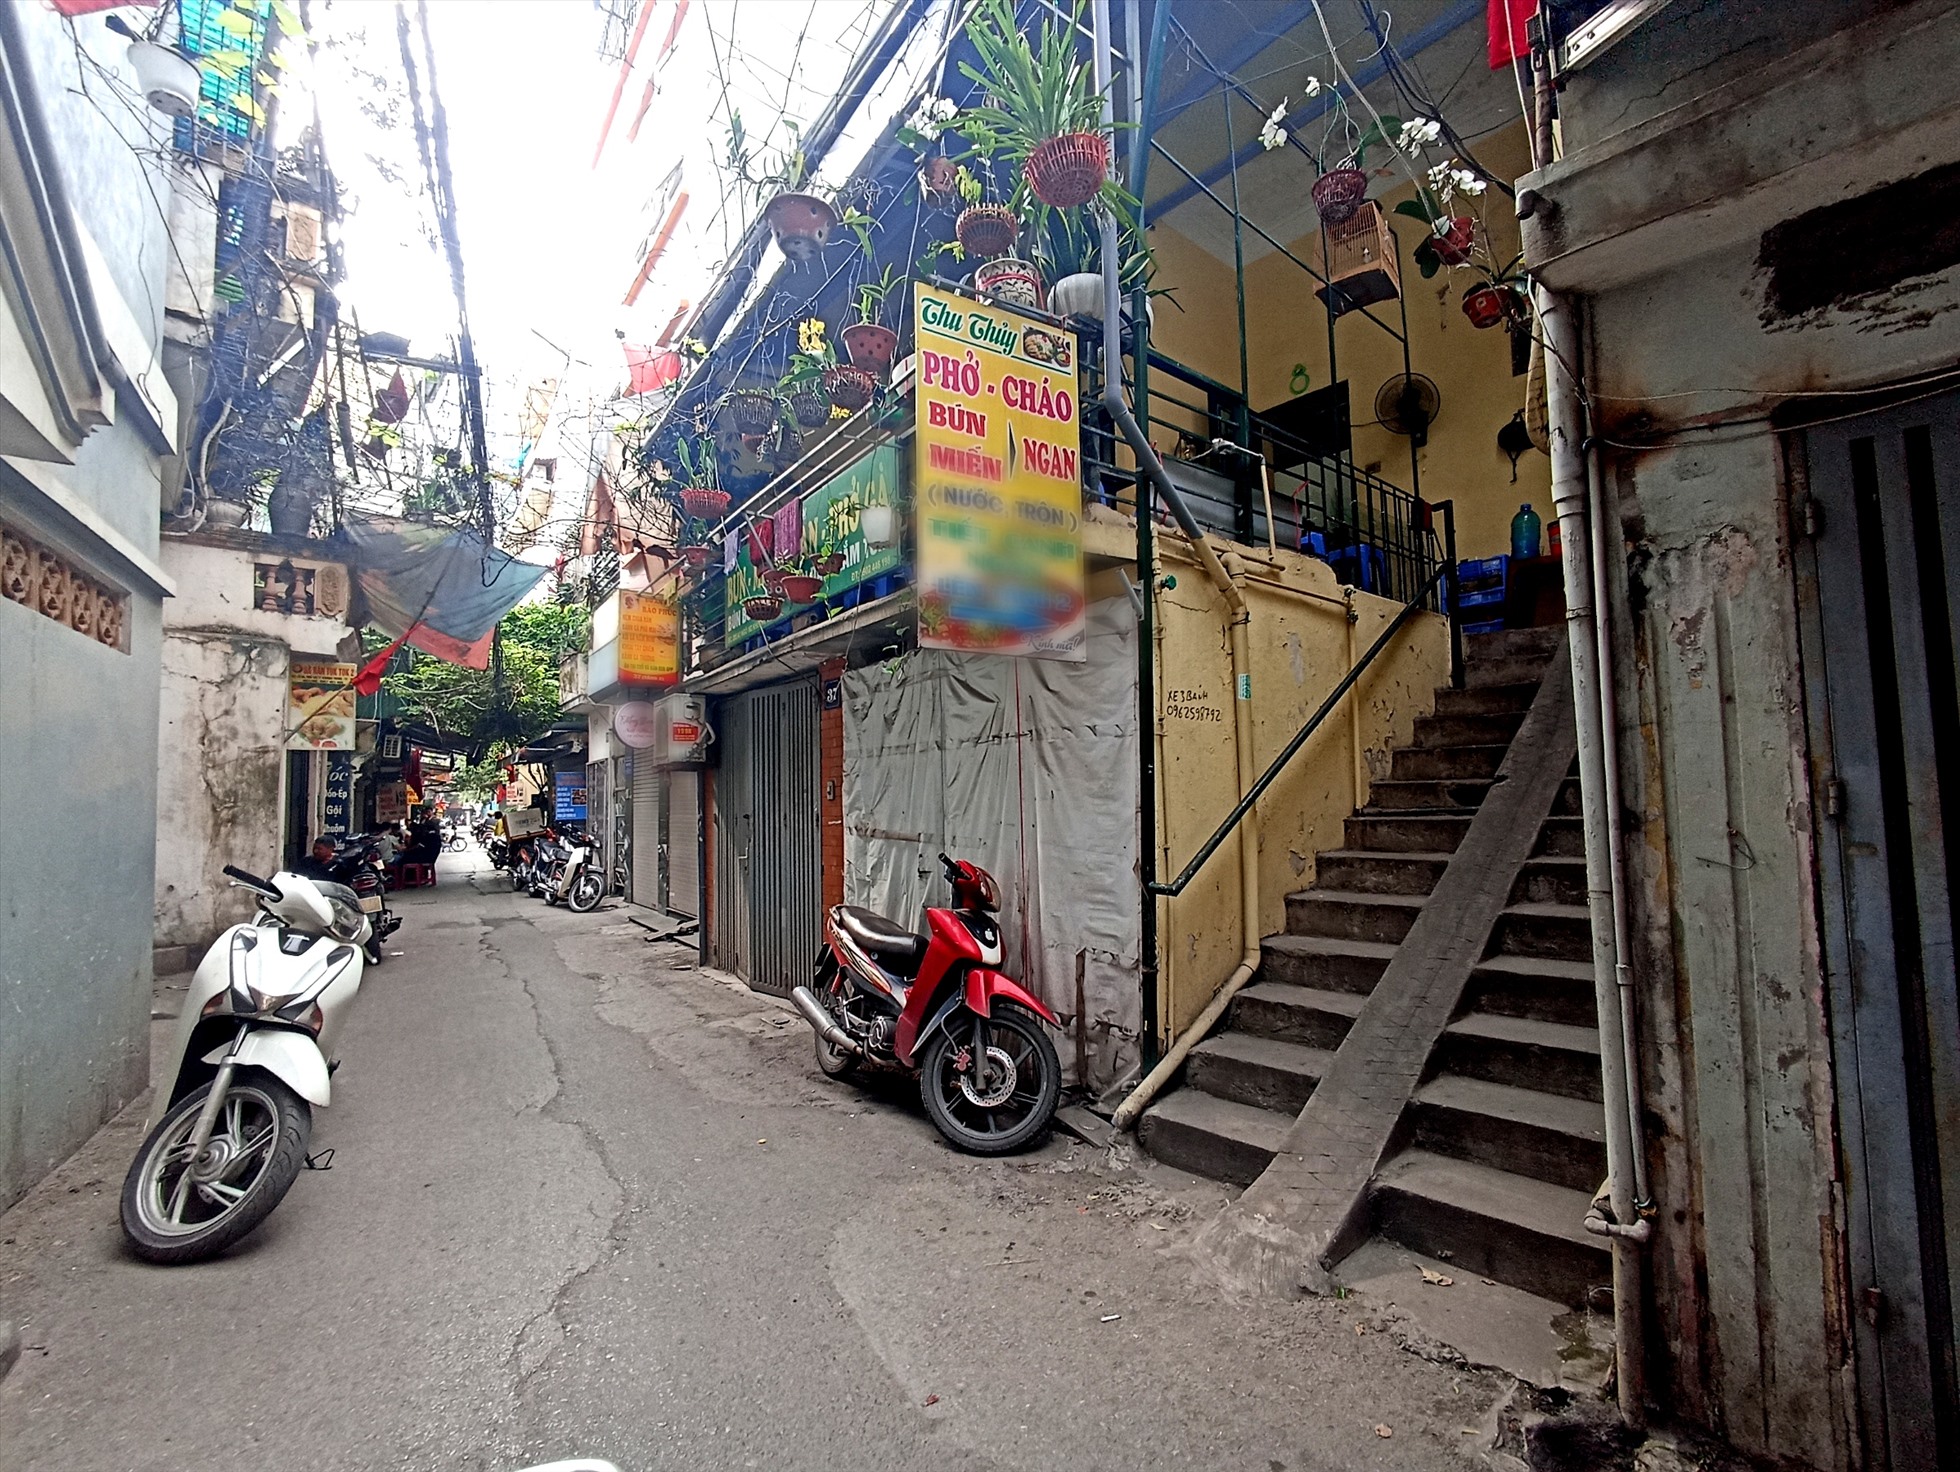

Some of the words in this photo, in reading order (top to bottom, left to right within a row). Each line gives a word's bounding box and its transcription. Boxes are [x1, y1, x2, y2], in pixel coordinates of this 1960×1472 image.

[922, 297, 963, 332] Thu
[968, 312, 1018, 357] Thủy
[922, 350, 980, 397] PHỞ
[1002, 374, 1073, 422] CHÁO
[929, 402, 986, 437] BÚN
[1023, 438, 1076, 481] NGAN
[827, 687, 838, 703] 37
